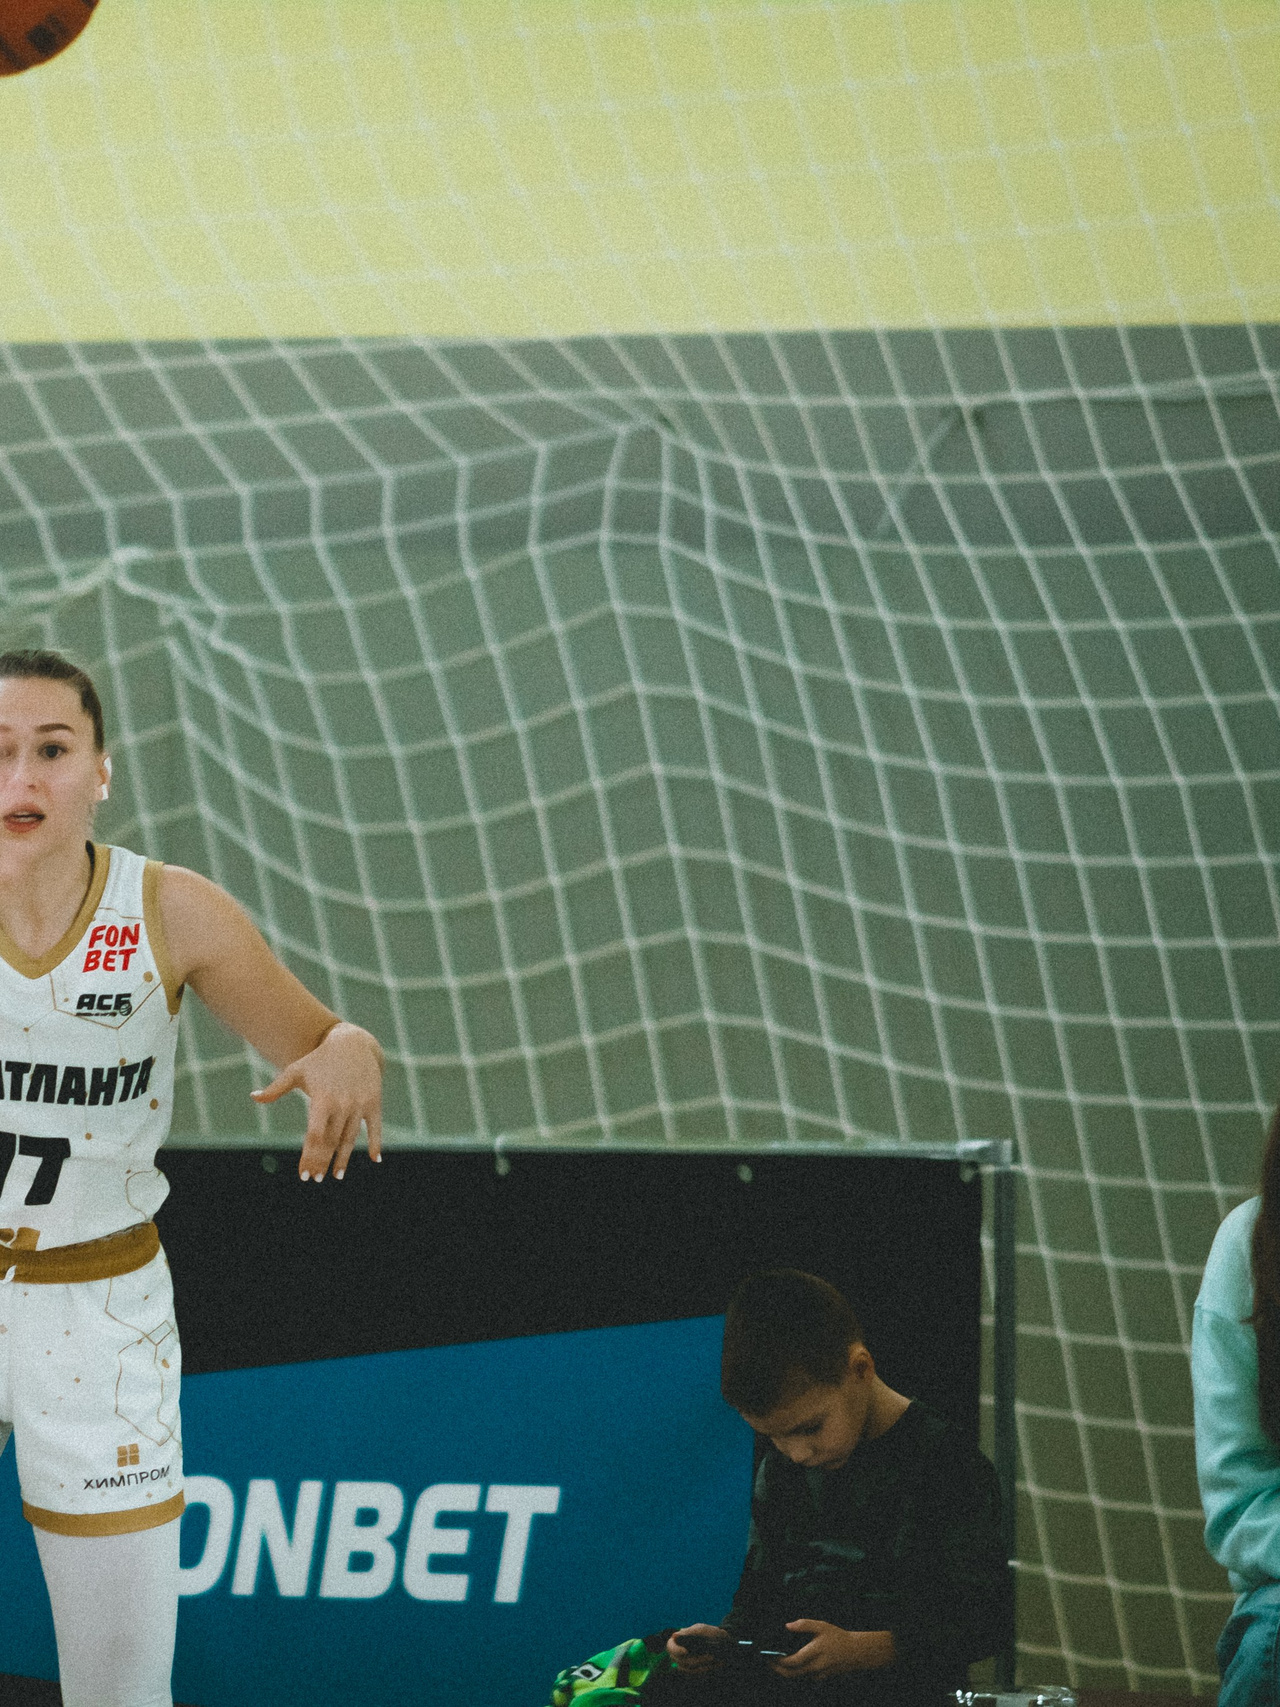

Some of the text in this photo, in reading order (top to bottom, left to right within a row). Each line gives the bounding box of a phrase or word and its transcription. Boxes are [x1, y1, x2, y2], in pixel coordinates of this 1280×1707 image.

[88, 923, 140, 949] FON
[82, 948, 137, 973] BET
[83, 1465, 170, 1490] ХИМПРОМ
[180, 1475, 561, 1604] ONBET
